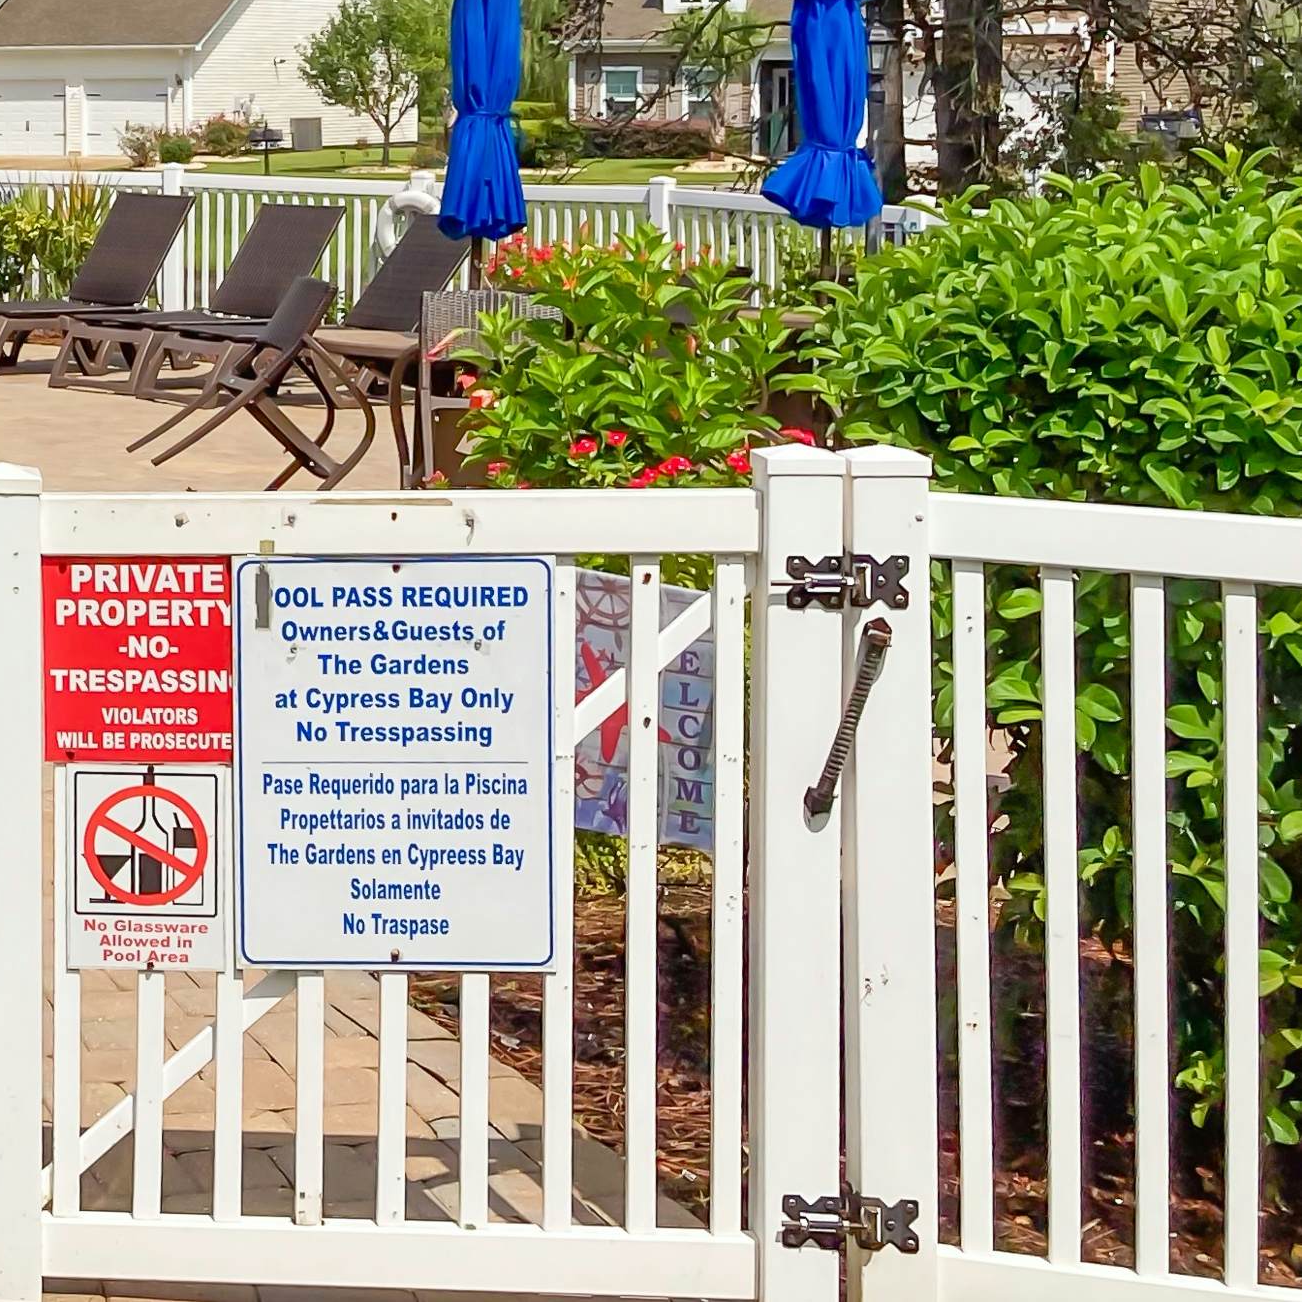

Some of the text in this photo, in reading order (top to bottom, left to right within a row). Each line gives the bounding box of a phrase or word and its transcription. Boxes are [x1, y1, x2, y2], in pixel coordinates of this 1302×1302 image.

[70, 563, 225, 594] PRIVATE
[270, 586, 529, 609] OOL PASS REQUIRED
[281, 620, 507, 641] Owners&Guests of
[118, 635, 179, 659] -NO-
[317, 654, 469, 675] The Gardens
[49, 668, 232, 693] TRESPASSIN
[275, 687, 514, 714] at Cypress Bay Only
[101, 707, 199, 726] VIOLATORS
[56, 731, 233, 750] WILL BE PROSECUTE
[296, 721, 493, 747] No Tresspassing
[676, 650, 704, 835] ELCOME
[262, 772, 528, 801] Pase Requerido para la Piscina
[280, 807, 511, 835] Propettarios a invitados de
[267, 843, 525, 871] The Gardens en Cypreess Bay
[350, 878, 442, 900] Solamente
[83, 919, 209, 934] No Glassware
[342, 913, 450, 940] No Traspase
[99, 934, 193, 949] Allowed in
[103, 949, 189, 963] Pool Area
